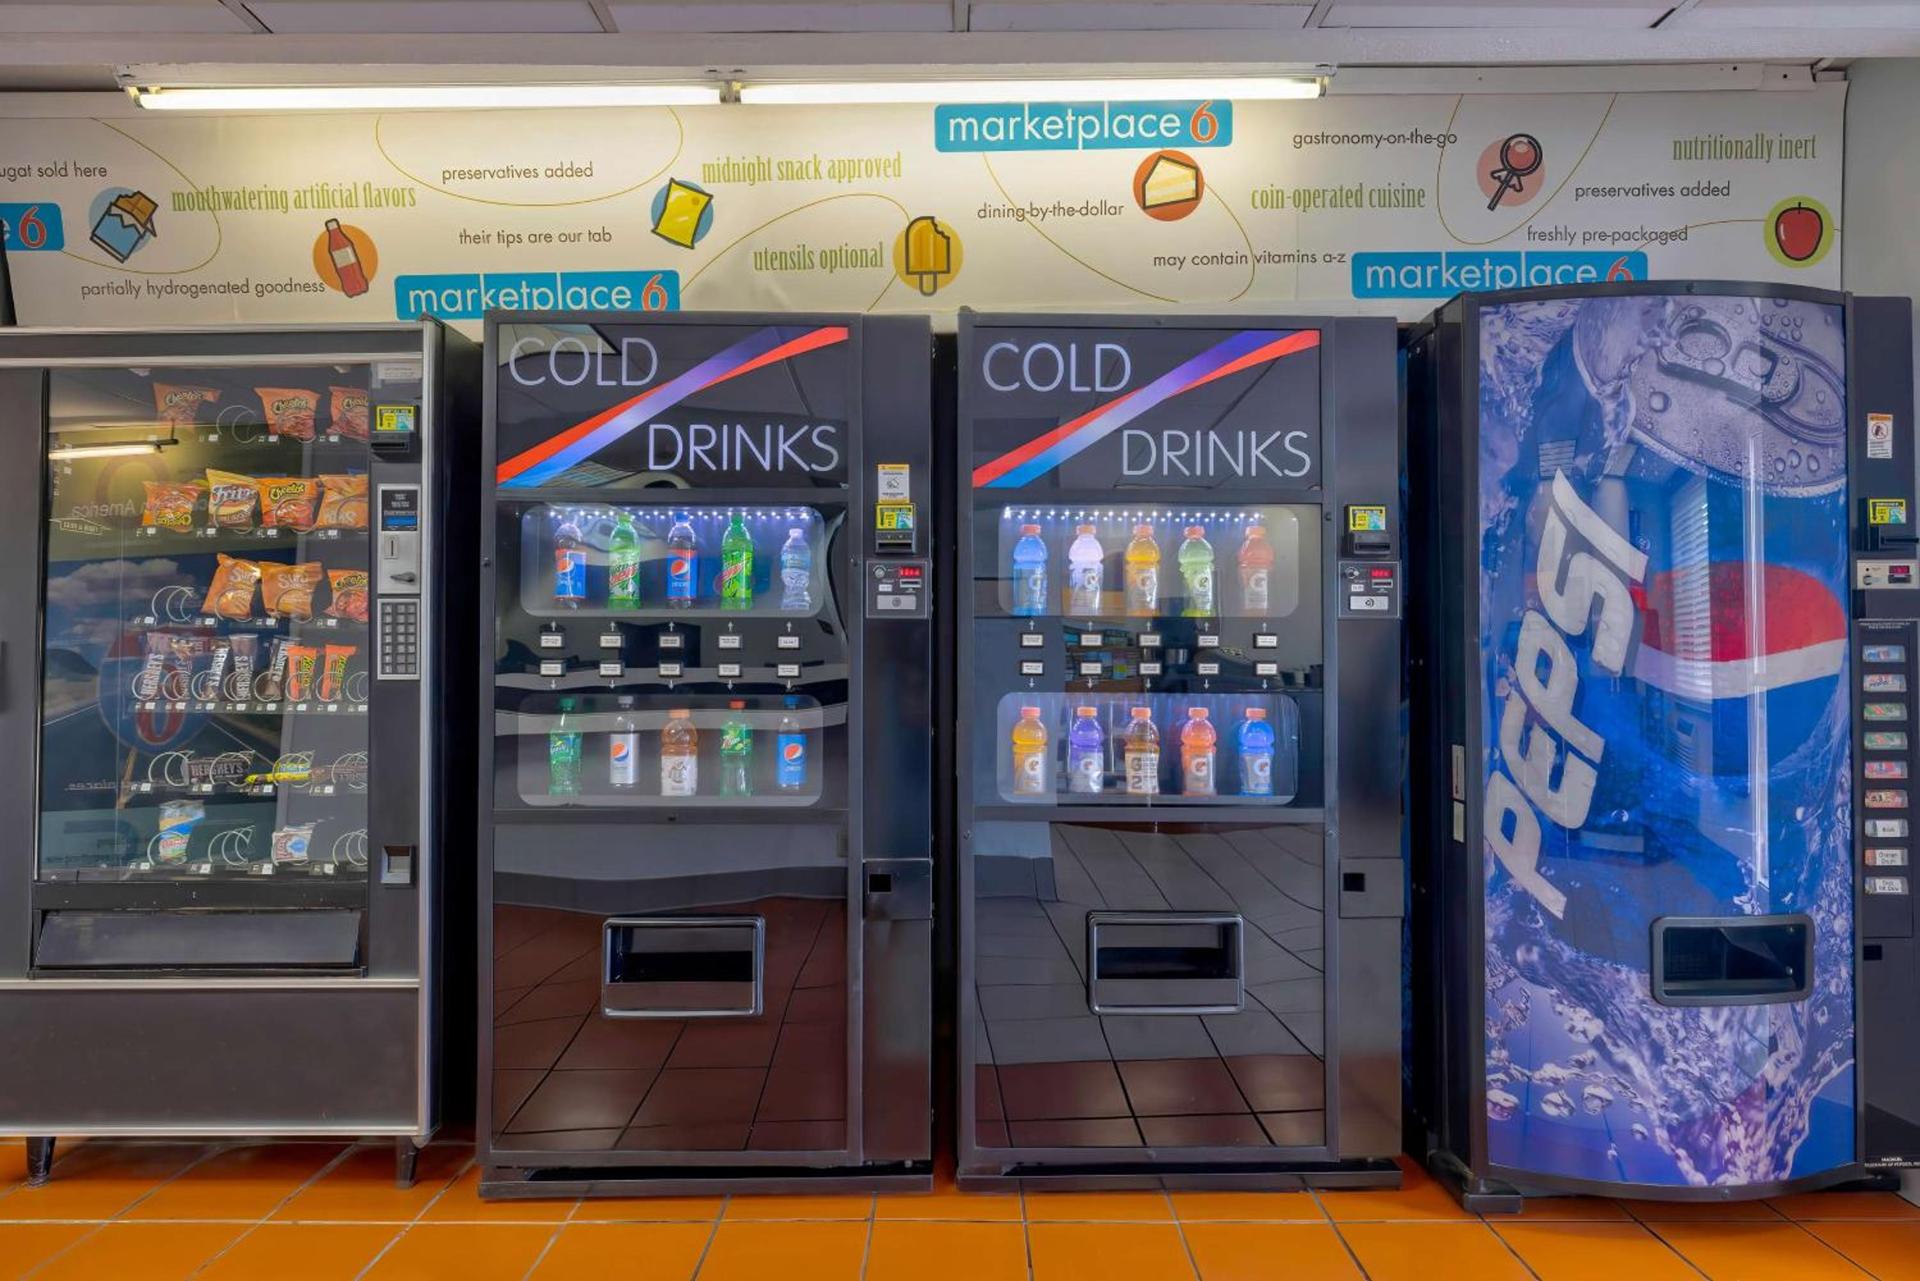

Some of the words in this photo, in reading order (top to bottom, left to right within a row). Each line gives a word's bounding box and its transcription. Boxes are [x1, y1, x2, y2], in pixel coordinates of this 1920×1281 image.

[948, 101, 1181, 150] marketplace
[1190, 100, 1218, 143] 6
[1293, 129, 1458, 149] gastronomy-on-the-go
[1673, 134, 1772, 162] nutritionally
[1778, 134, 1816, 160] inert
[37, 161, 68, 178] sold
[73, 161, 108, 178] here
[442, 165, 539, 184] preservatives
[544, 161, 594, 178] added
[702, 155, 772, 186] midnight
[777, 153, 823, 181] snack
[827, 151, 902, 183] approved
[171, 184, 289, 214] mouthwatering
[293, 182, 360, 209] artificial
[363, 181, 417, 208] flavors
[1250, 183, 1364, 213] coin-operated
[1368, 183, 1426, 208] cuisine
[1575, 182, 1674, 200] preservatives
[1680, 180, 1730, 197] added
[19, 205, 47, 249] 6
[977, 200, 1125, 222] dining-by-the-dollar
[459, 228, 492, 245] their
[497, 228, 523, 248] tips
[528, 231, 553, 244] are
[558, 230, 582, 243] our
[587, 226, 613, 243] tab
[1527, 226, 1576, 246] freshly
[1582, 226, 1688, 247] pre-packaged
[753, 243, 815, 271] utensils
[819, 242, 885, 274] optional
[1153, 253, 1186, 271] may
[1191, 251, 1249, 266] contain
[1254, 249, 1317, 265] vitamins
[1323, 252, 1347, 264] a-z
[1366, 252, 1597, 289] marketplace
[81, 280, 142, 300] partially
[146, 278, 250, 299] hydrogenated
[255, 278, 326, 298] goodness
[409, 273, 632, 313] marketplace
[641, 273, 668, 311] 6
[509, 336, 659, 387] COLD
[982, 342, 1132, 393] COLD
[648, 423, 840, 472] DRINKS
[1122, 429, 1311, 477] DRINKS
[1484, 468, 1649, 921] PEPSI
